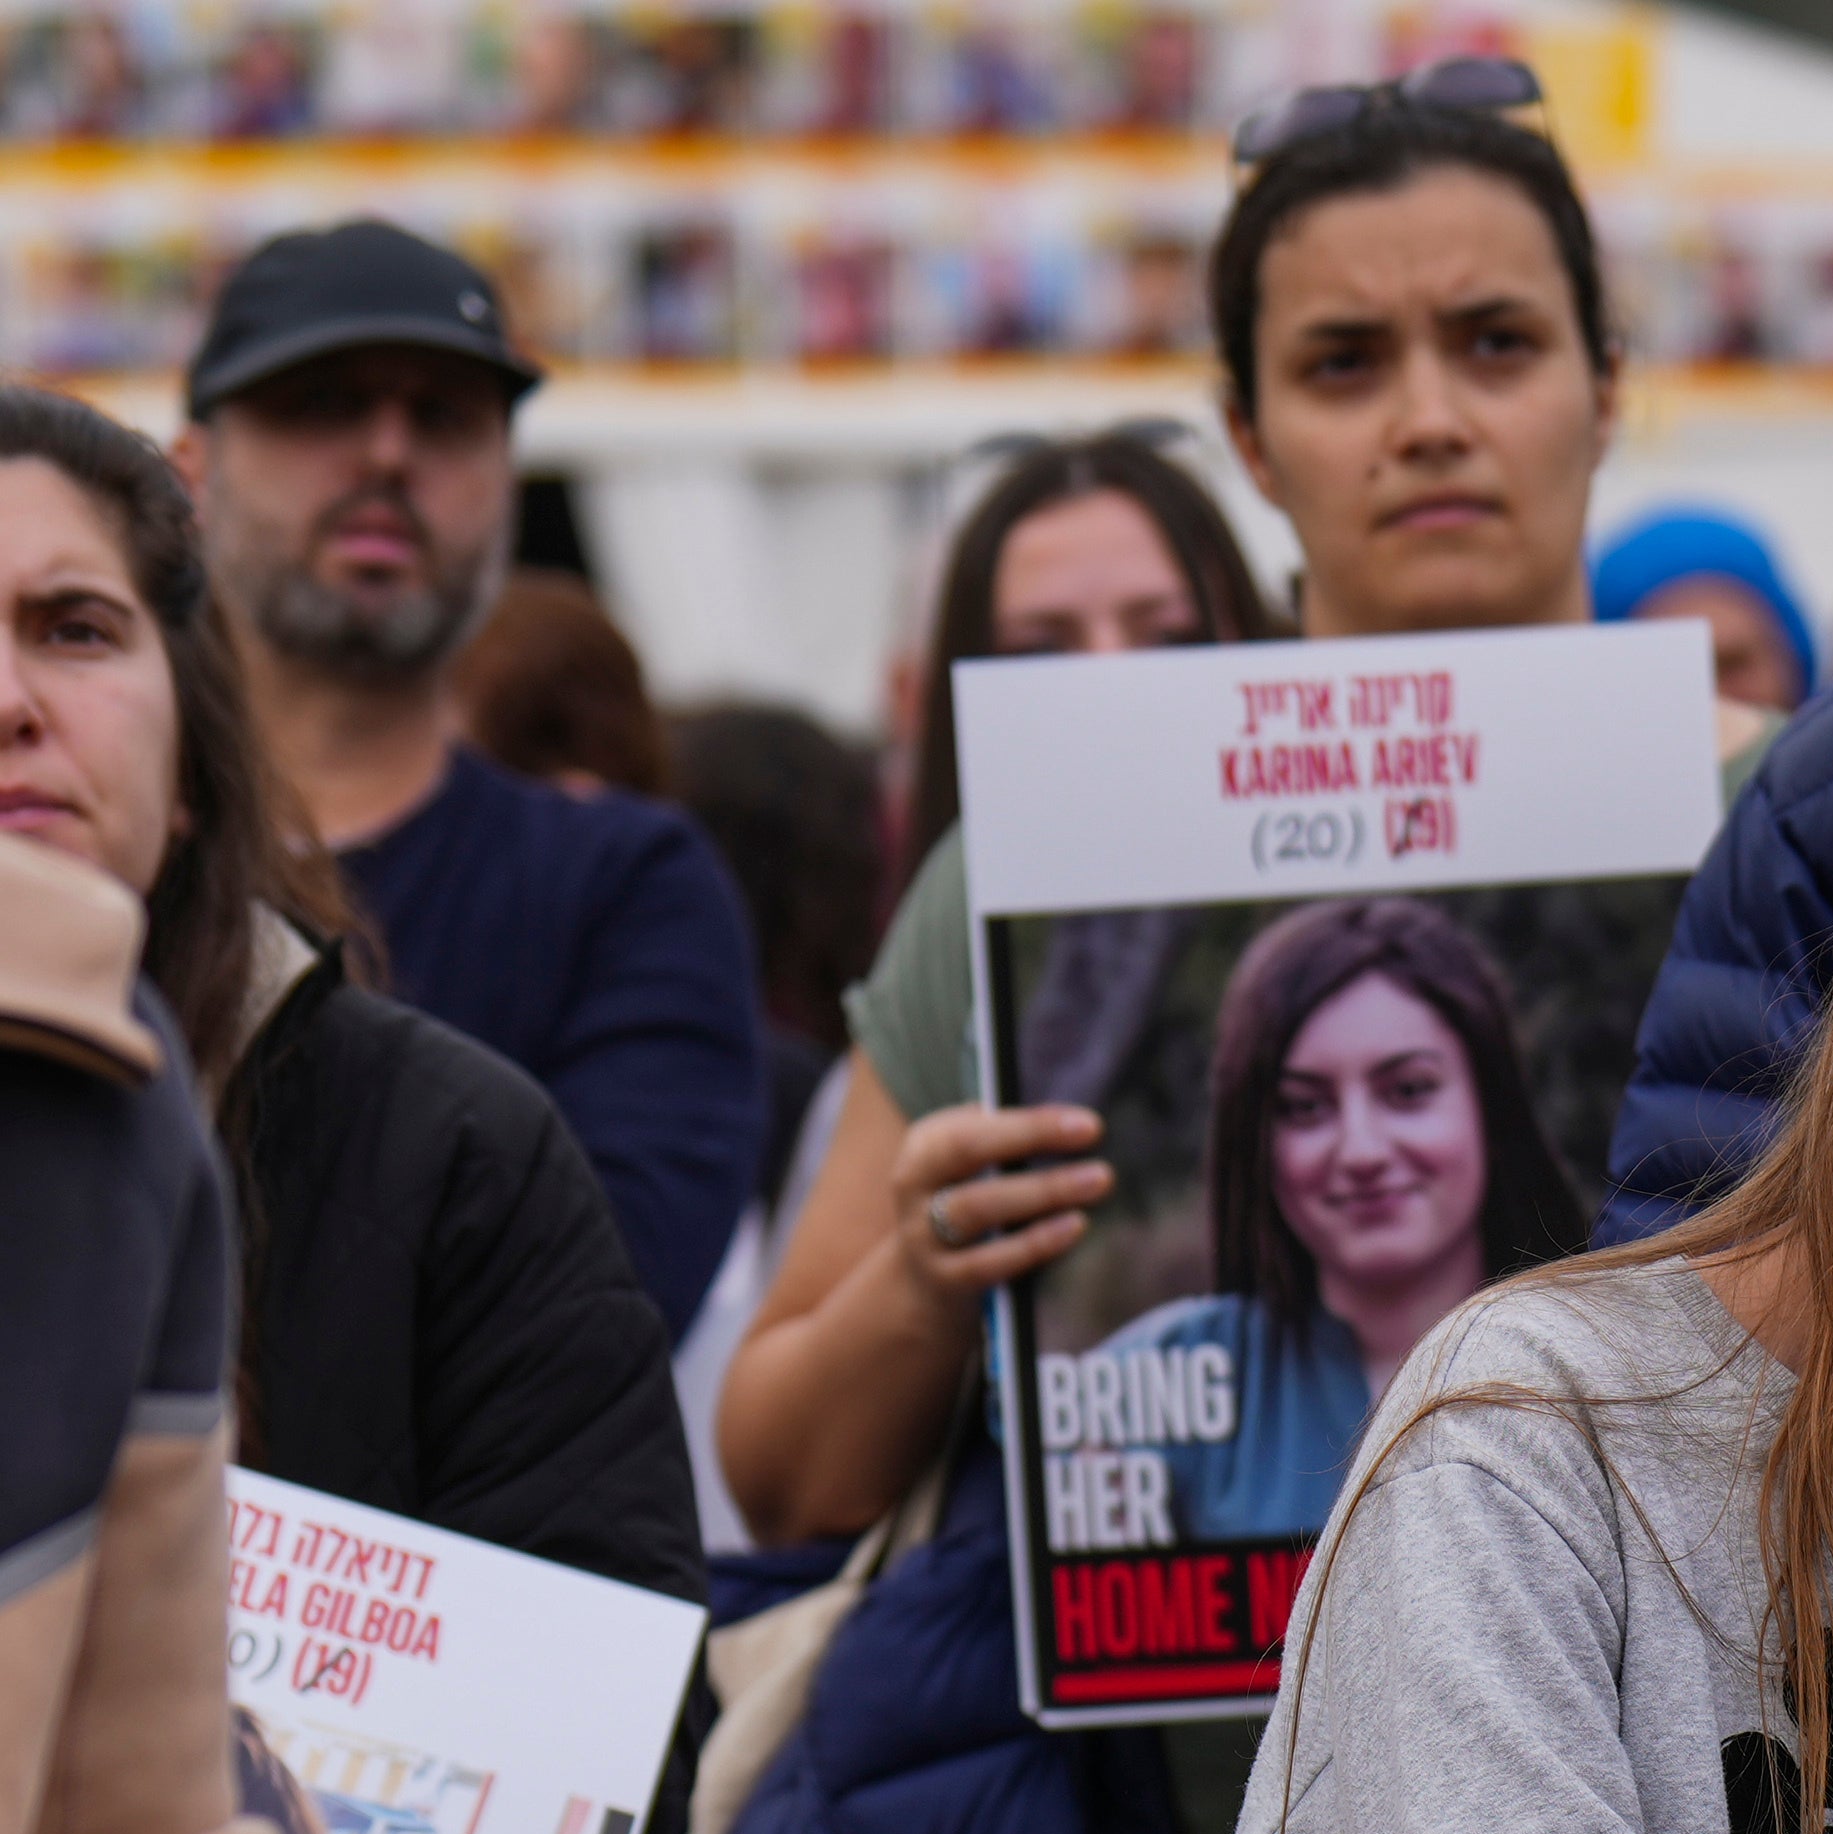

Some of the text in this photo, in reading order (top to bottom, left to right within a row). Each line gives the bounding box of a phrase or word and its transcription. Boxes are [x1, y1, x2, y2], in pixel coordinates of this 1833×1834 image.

[1350, 671, 1453, 728] קרינה
[1220, 734, 1479, 800] KARINA ARIEV
[1251, 806, 1365, 872] (20)
[1037, 1344, 1236, 1450] BRING
[1044, 1450, 1176, 1554] HER
[292, 1520, 438, 1599] דניאלה
[301, 1582, 441, 1662] GILBOA
[1053, 1552, 1237, 1662] HOME
